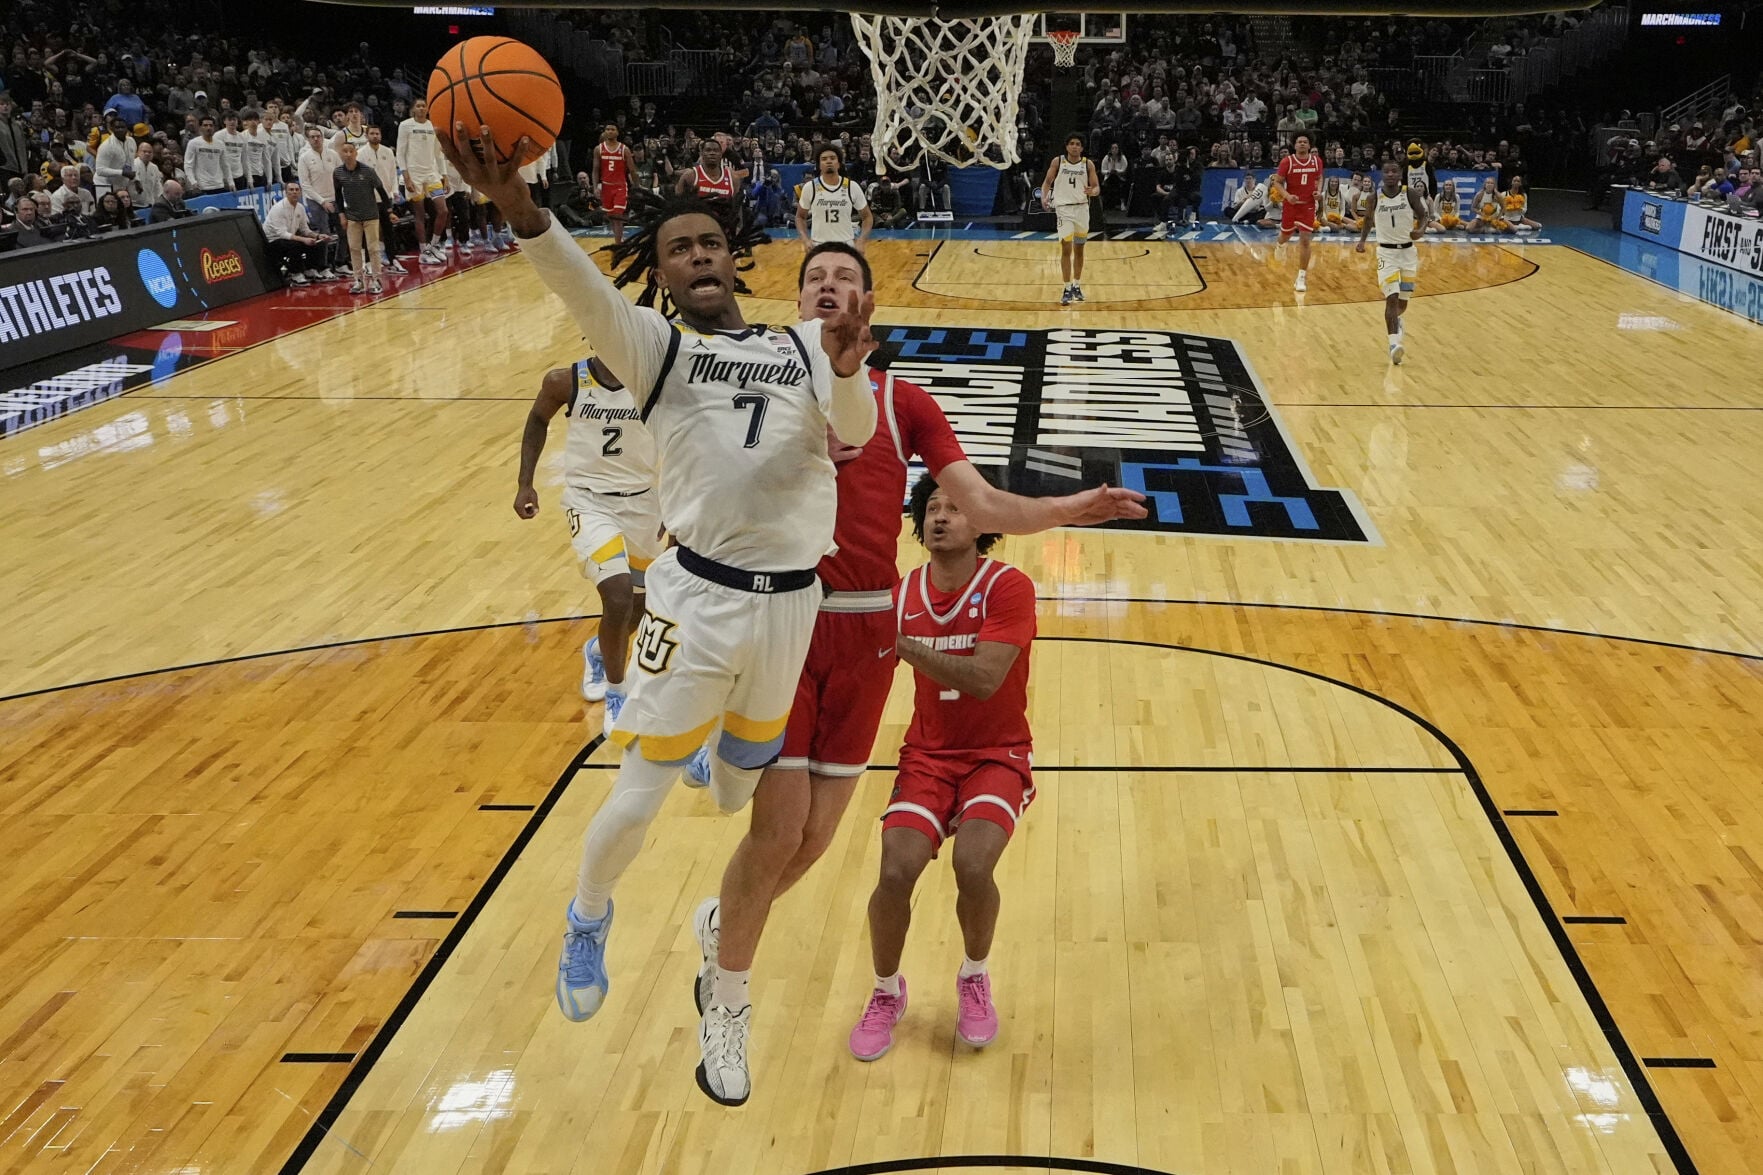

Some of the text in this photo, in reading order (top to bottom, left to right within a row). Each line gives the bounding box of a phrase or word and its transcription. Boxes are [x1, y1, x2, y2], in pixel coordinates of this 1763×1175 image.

[608, 161, 614, 171] 2
[1068, 177, 1076, 188] 4
[1301, 174, 1307, 184] 0
[825, 209, 839, 223] 13
[1390, 215, 1395, 228] 1
[1701, 215, 1742, 263] FIRST
[1750, 228, 1763, 273] S
[203, 252, 241, 281] Reese's
[149, 275, 176, 295] NCAA
[0, 266, 122, 343] ATHLETES
[688, 353, 806, 389] Marquette
[1036, 329, 1206, 452] MADNESS
[732, 393, 769, 448] 7
[602, 427, 623, 457] 2
[752, 575, 774, 592] AL
[637, 609, 680, 675] MU
[935, 633, 978, 651] MEXIC
